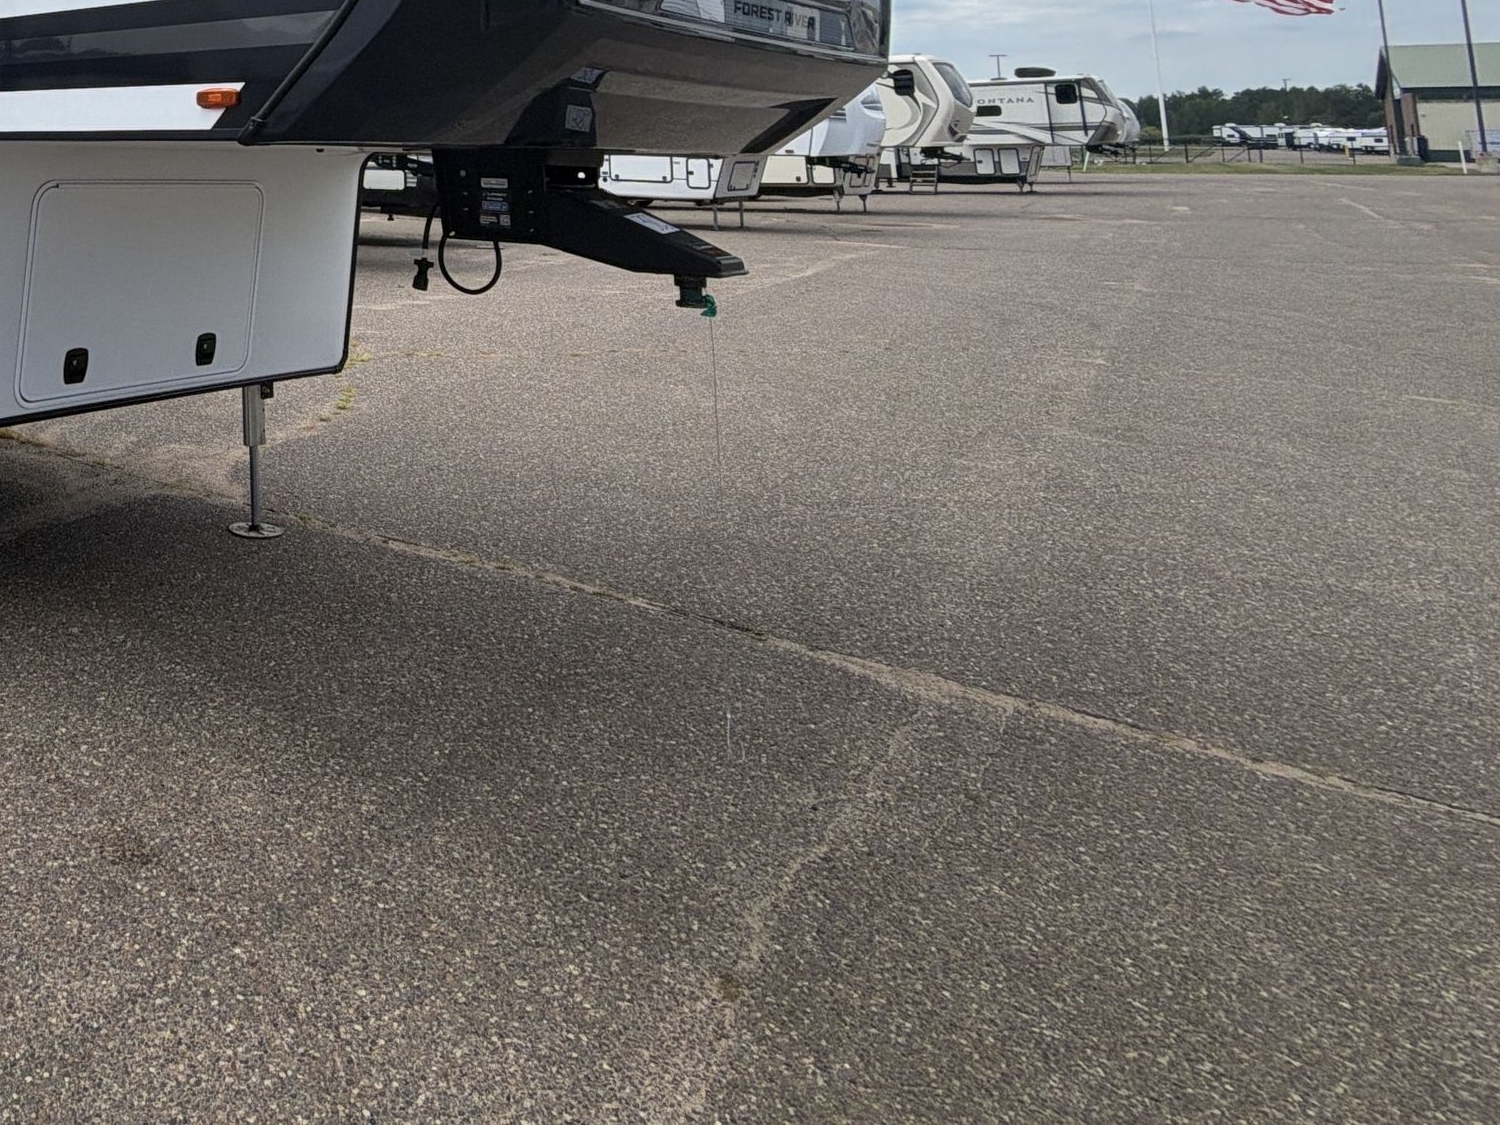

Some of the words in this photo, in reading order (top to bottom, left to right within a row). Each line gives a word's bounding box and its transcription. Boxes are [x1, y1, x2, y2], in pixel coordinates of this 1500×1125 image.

[733, 0, 782, 22] FOREST
[784, 11, 816, 29] RIVER
[976, 97, 1034, 105] ONTANA
